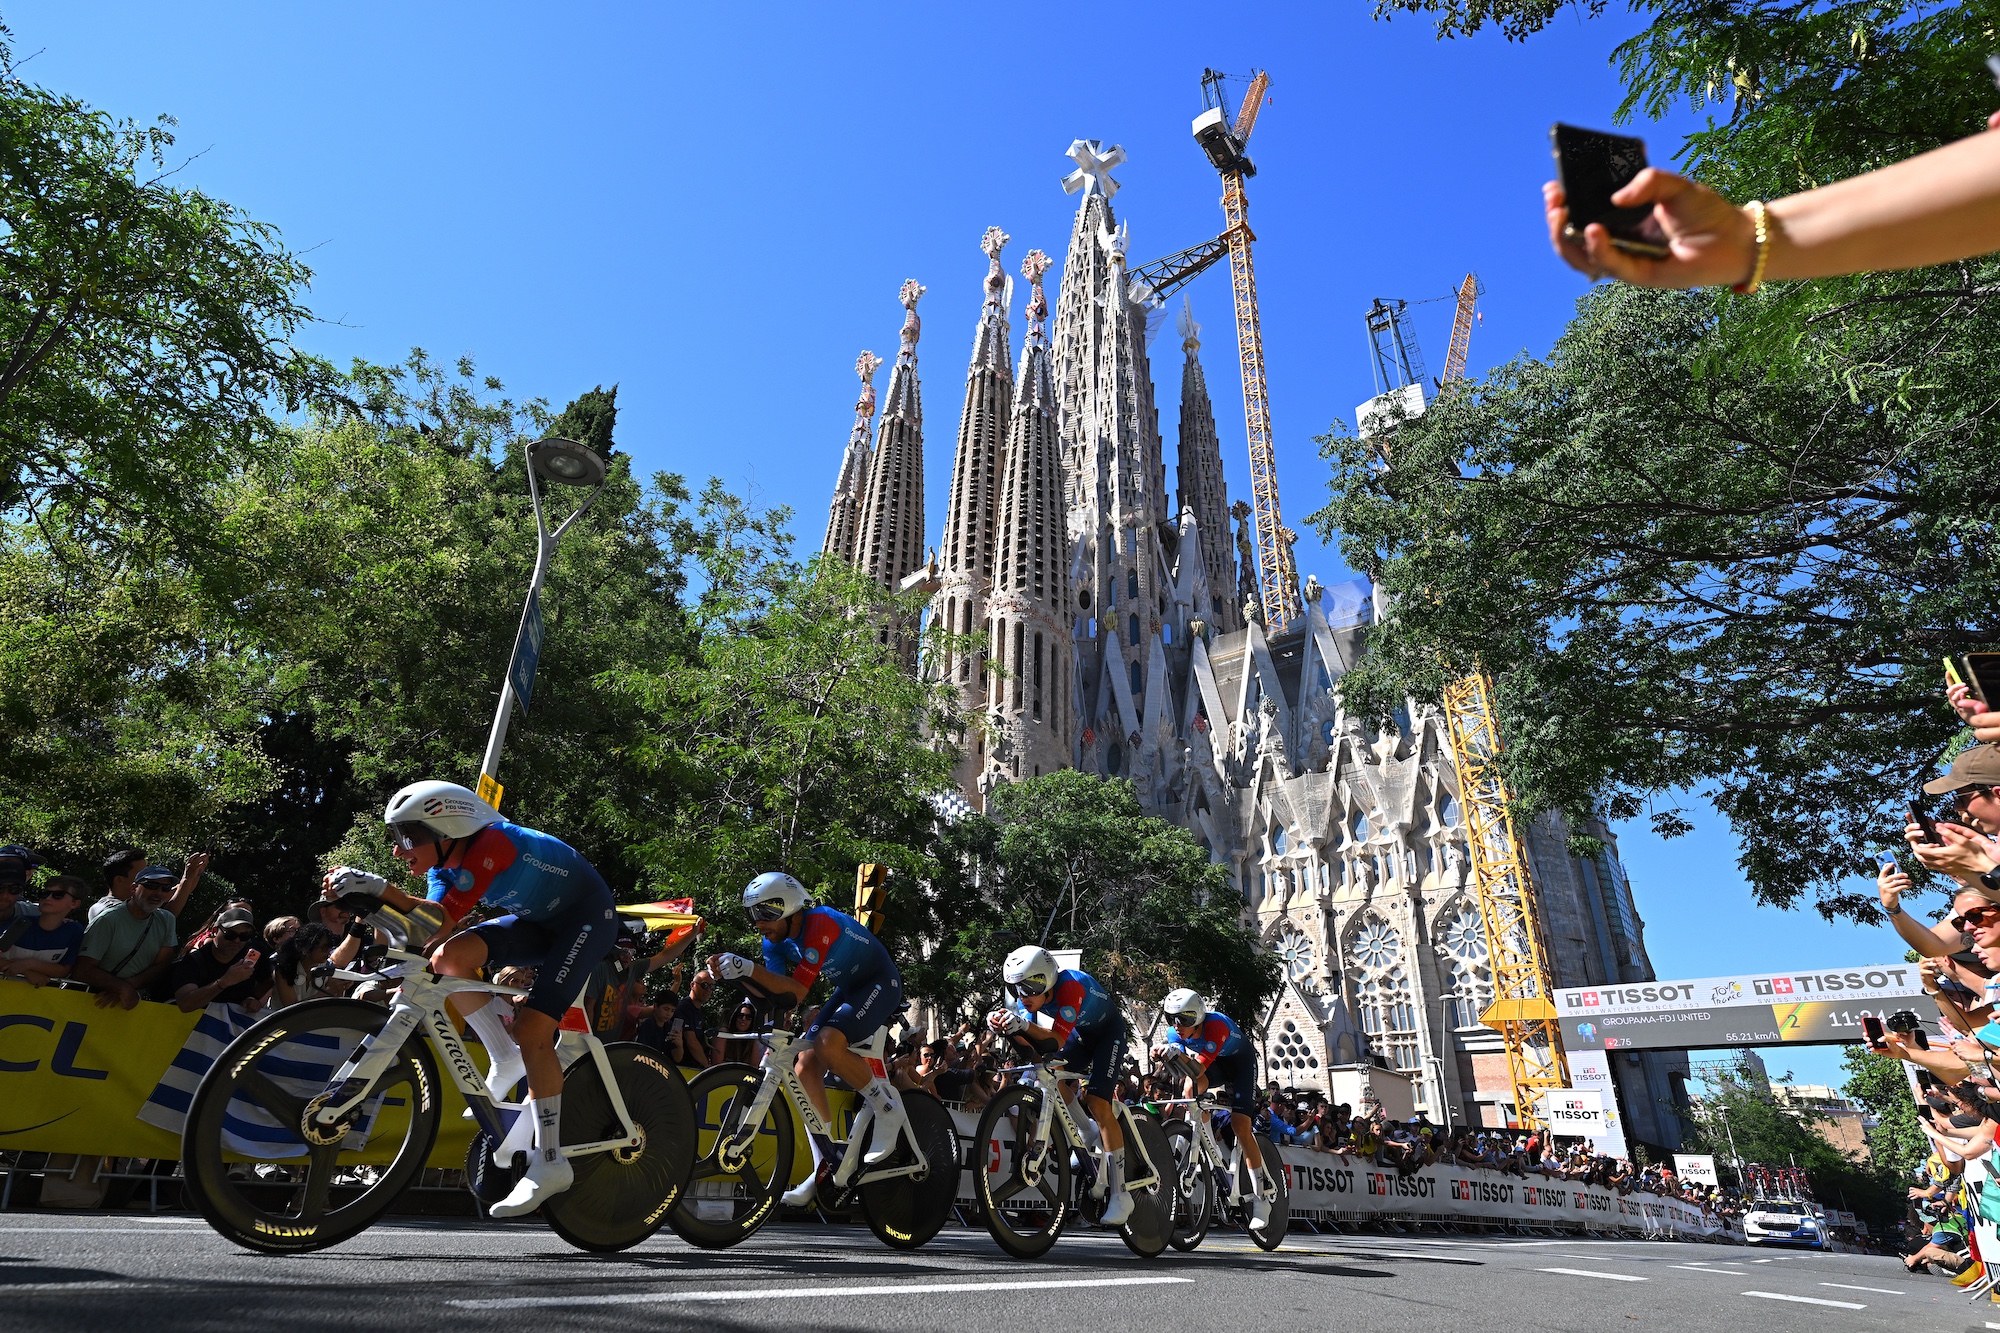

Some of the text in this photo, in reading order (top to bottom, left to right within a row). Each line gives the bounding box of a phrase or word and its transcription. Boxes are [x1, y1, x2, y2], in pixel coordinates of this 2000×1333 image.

[522, 852, 569, 878] Groupama
[844, 927, 870, 945] Groupama
[555, 931, 589, 985] FDJ UNITED
[1794, 970, 1908, 992] TISSOT
[855, 989, 880, 1020] FDJ UNITED
[1601, 985, 1694, 1005] TISSOT
[1794, 993, 1845, 1001] WATCHES
[1600, 1006, 1641, 1014] WATCHES
[1603, 1012, 1711, 1026] GROUPAMA-FDJ UNITED
[1787, 1014, 1801, 1029] 2
[1726, 1031, 1779, 1041] 55.21 km/h
[230, 1028, 287, 1080] MICHE
[1110, 1044, 1120, 1066] UNITED
[633, 1054, 670, 1080] MICHE
[411, 1058, 431, 1114] MICHE
[1553, 1110, 1599, 1120] TISSOT
[475, 1137, 490, 1186] MICHE
[1294, 1164, 1354, 1194] TISSOT
[1385, 1174, 1436, 1198] TISSOT
[1470, 1181, 1514, 1203] TISSOT
[1537, 1187, 1566, 1208] TISSOT
[1585, 1193, 1611, 1212] TISSOT
[643, 1184, 678, 1226] MICHE
[741, 1195, 773, 1230] MICHE
[253, 1218, 319, 1237] MICHE
[885, 1224, 913, 1242] MICHE
